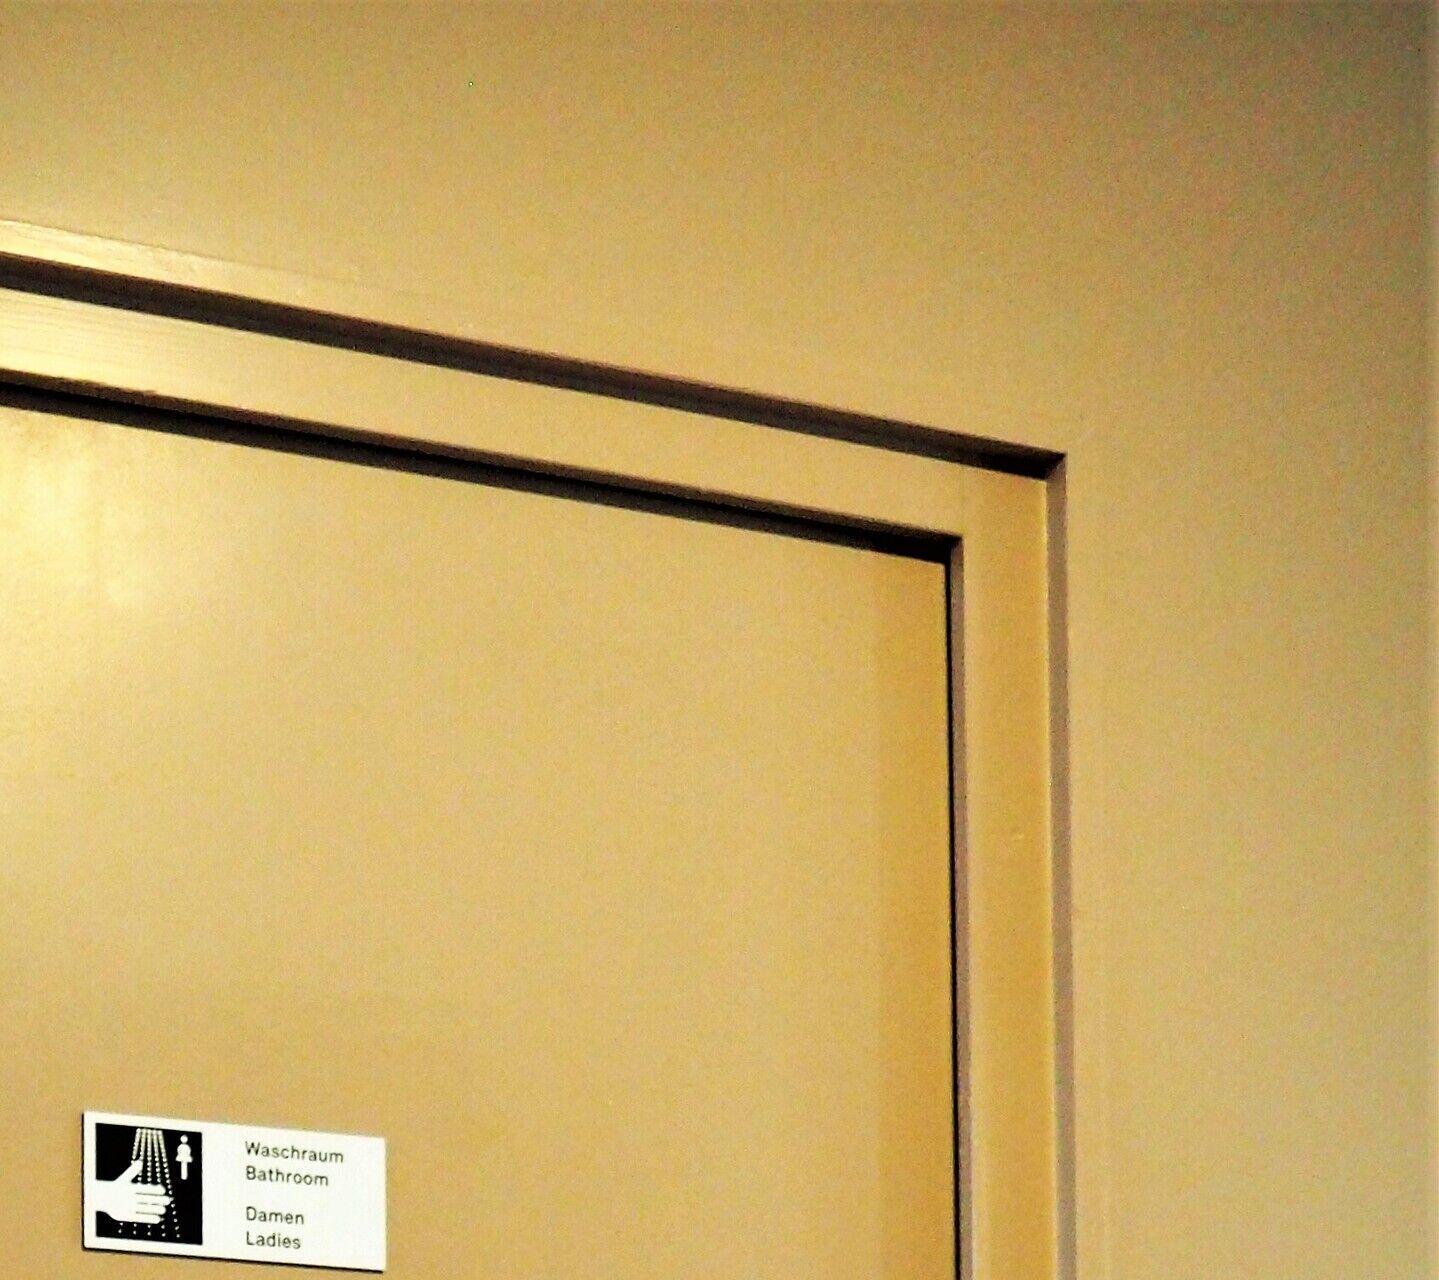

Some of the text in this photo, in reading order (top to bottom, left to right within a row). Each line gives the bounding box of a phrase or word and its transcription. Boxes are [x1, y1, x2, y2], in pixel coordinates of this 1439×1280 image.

[245, 1140, 344, 1163] Waschraum
[246, 1165, 329, 1186] Bathroom
[246, 1206, 304, 1225] Damen
[246, 1231, 301, 1249] Ladies
